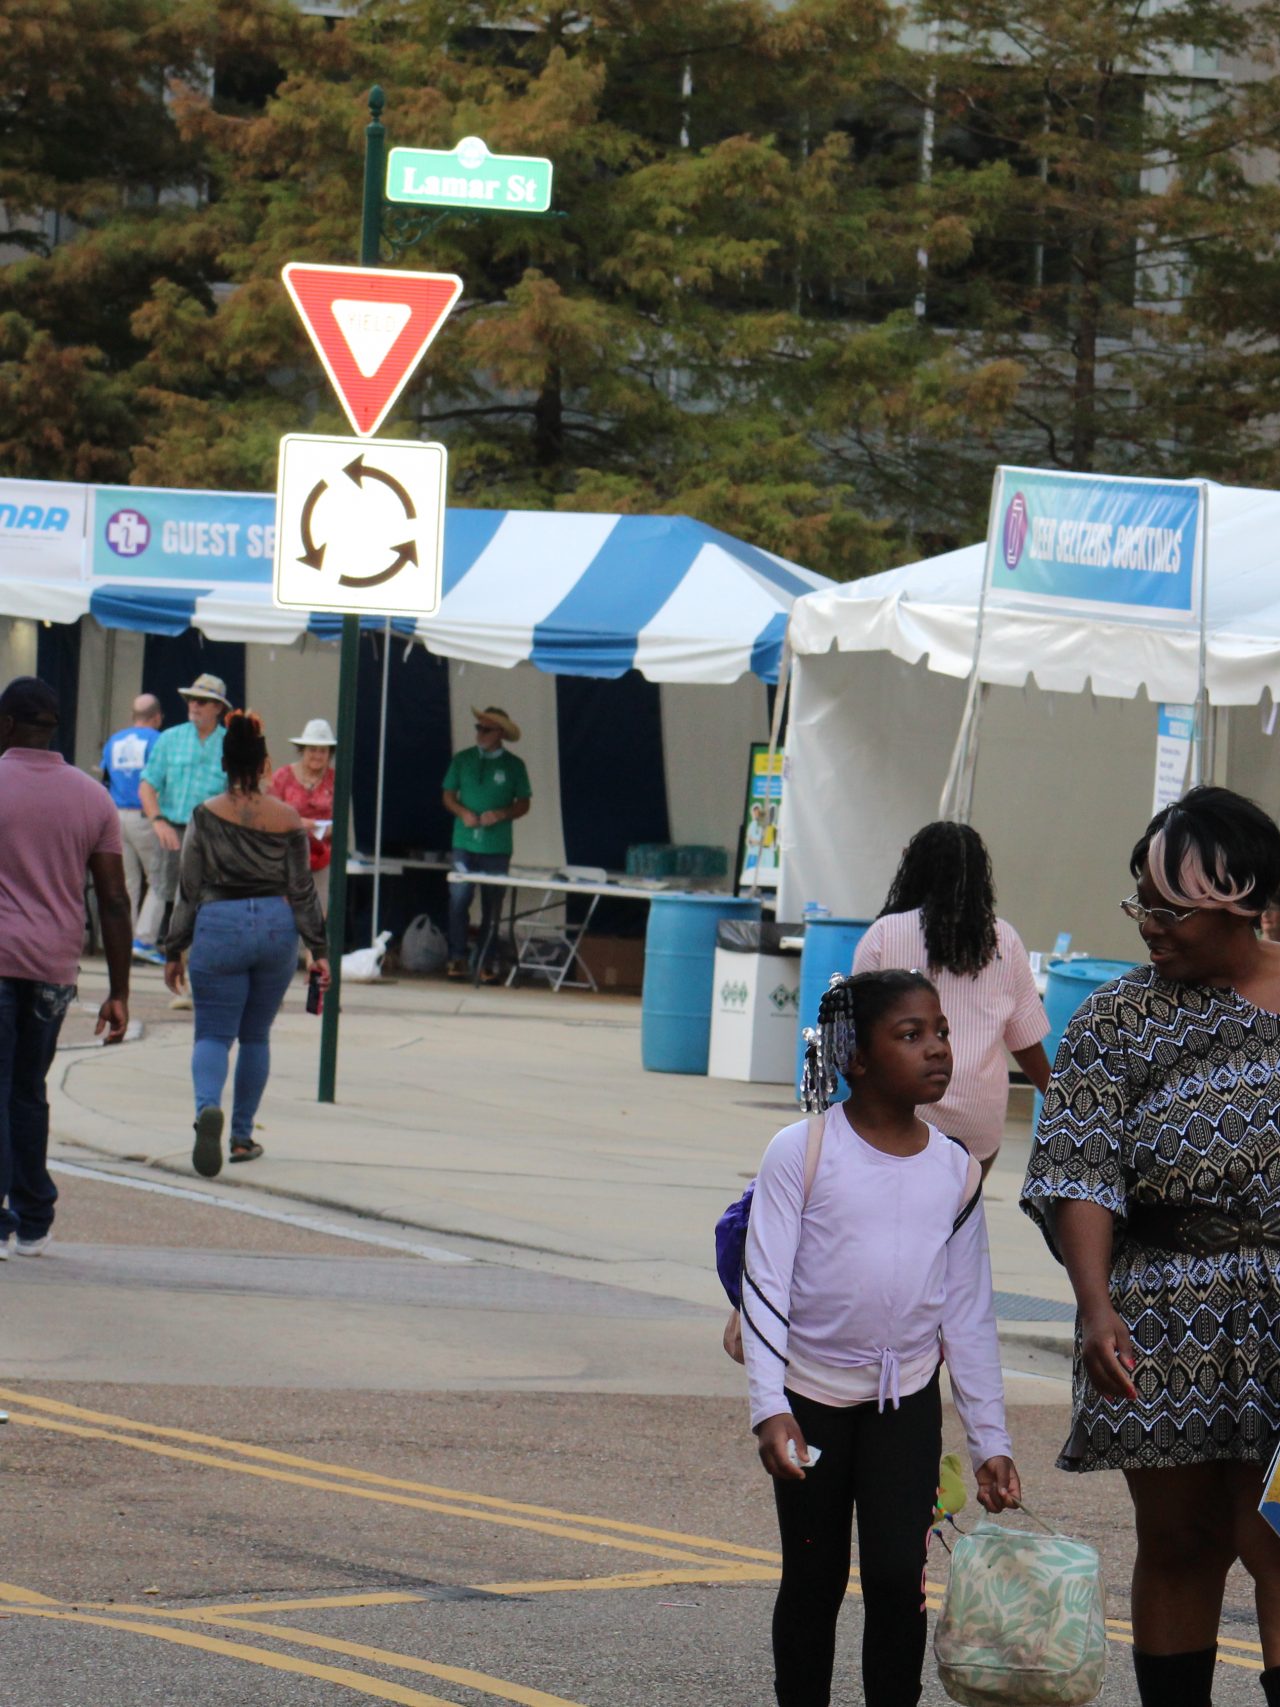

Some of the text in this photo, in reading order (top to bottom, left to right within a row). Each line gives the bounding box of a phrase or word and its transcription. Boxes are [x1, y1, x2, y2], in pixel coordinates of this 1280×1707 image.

[402, 167, 539, 203] Lamar St
[347, 313, 396, 332] YIELD
[162, 520, 240, 557] GUEST
[1113, 524, 1184, 574] COCKTAILS
